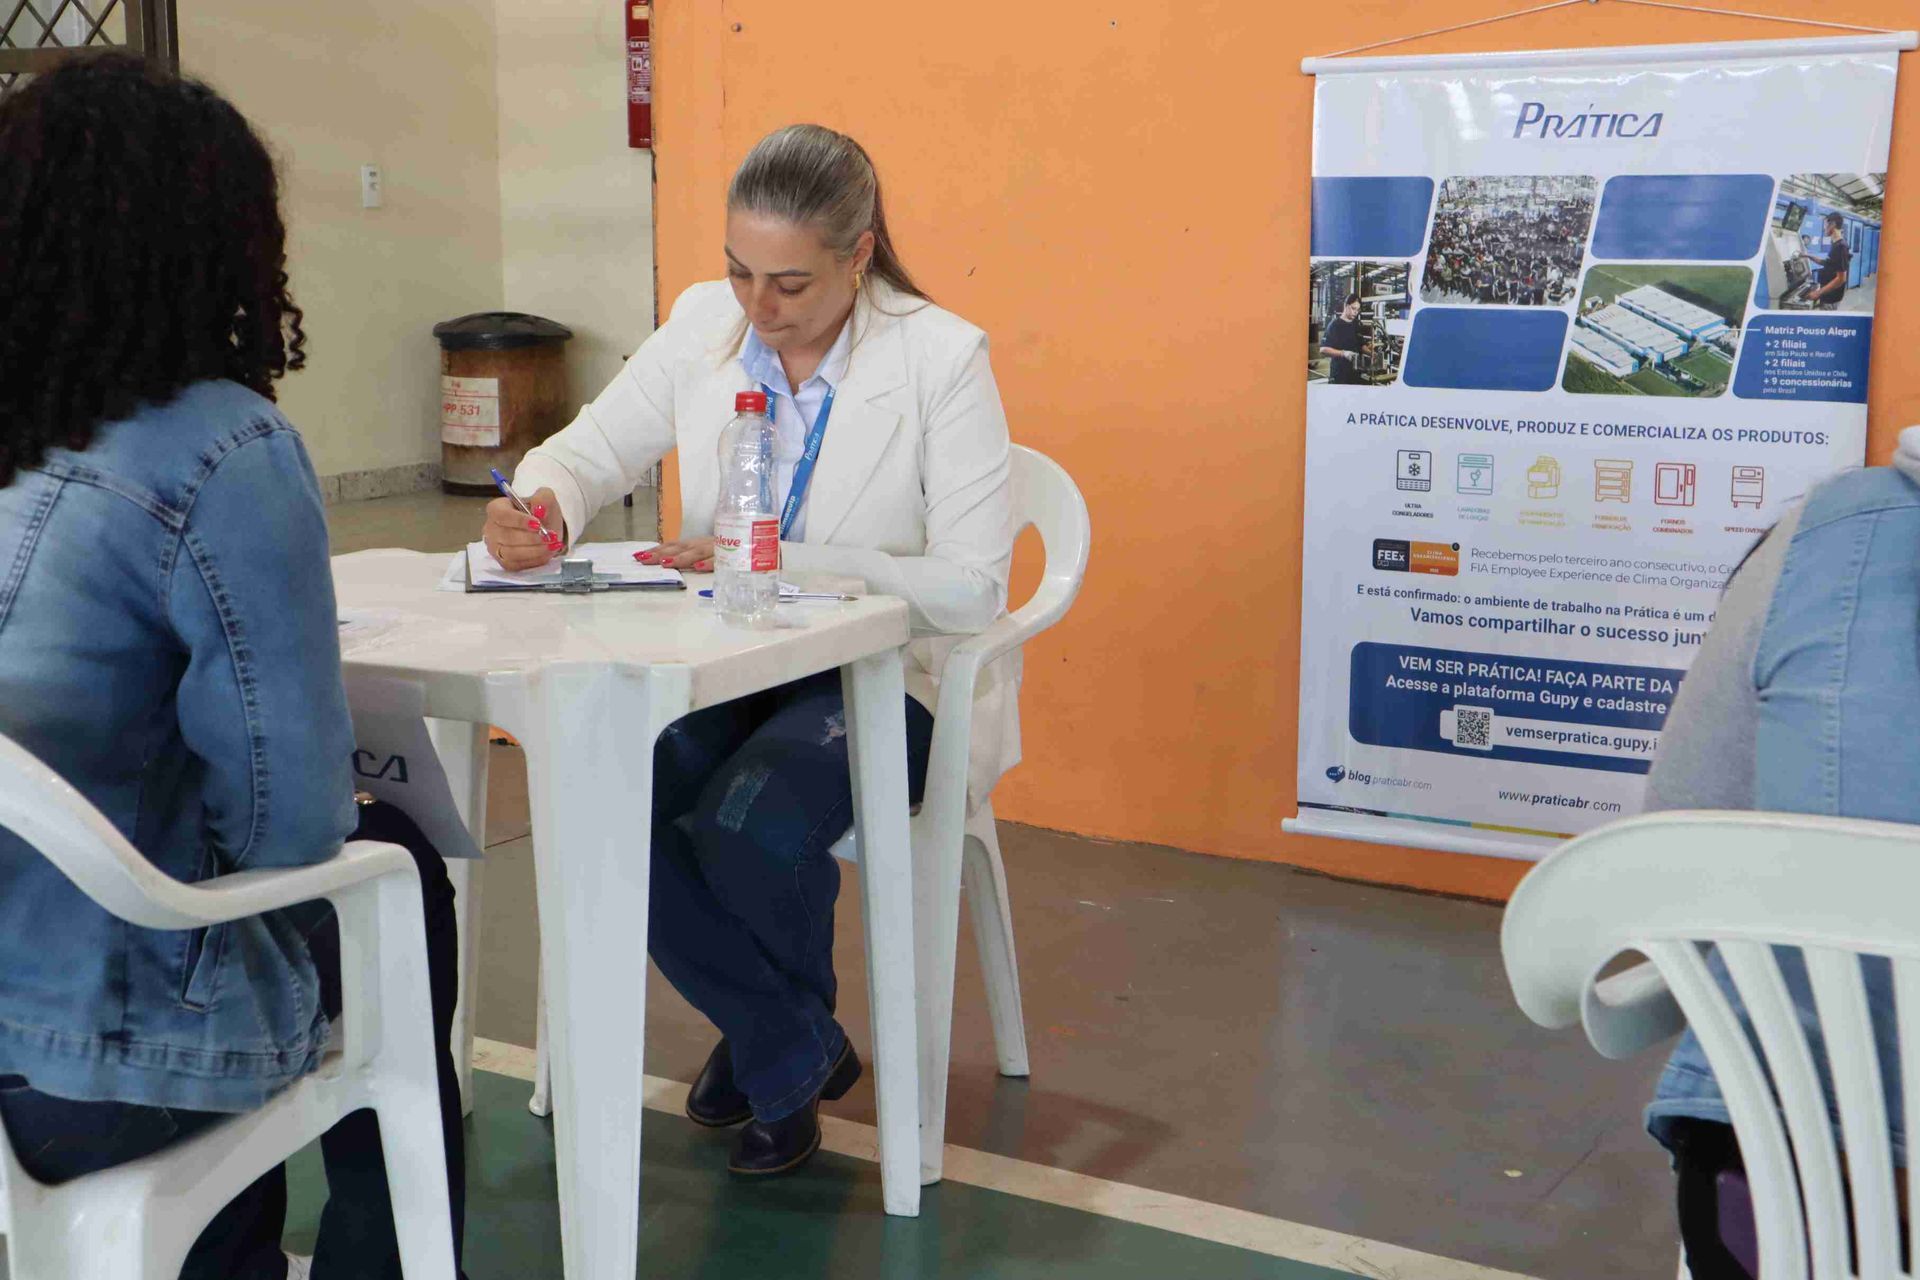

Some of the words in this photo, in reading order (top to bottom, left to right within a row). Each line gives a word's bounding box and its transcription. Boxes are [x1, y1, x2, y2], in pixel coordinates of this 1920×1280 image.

[1765, 326, 1795, 335] Matriz
[1797, 326, 1826, 335] Pouso
[1828, 327, 1857, 337] Alegre
[1774, 340, 1779, 348] 2
[1782, 340, 1807, 349] filiais
[1772, 359, 1778, 367] 2
[1781, 359, 1806, 368] filiais
[1771, 377, 1778, 385] 9
[1779, 378, 1852, 388] concessionárias
[460, 404, 480, 416] 531
[1346, 412, 1356, 425] A
[1360, 411, 1417, 428] PRÁTICA
[1421, 416, 1513, 434] DESENVOLVE,
[1517, 420, 1577, 436] PRODUZ
[1580, 423, 1589, 436] E
[1592, 423, 1708, 441] COMERCIALIZA
[1712, 428, 1733, 441] OS
[1738, 429, 1829, 446] PRODUTOS:
[1377, 549, 1405, 562] FEEx
[1471, 547, 1537, 562] Recebemos
[1539, 553, 1563, 564] pelo
[1565, 555, 1608, 567] terceiro
[1609, 559, 1632, 569] ano
[1633, 560, 1707, 574] consecutivo,
[1708, 565, 1716, 573] o
[1470, 562, 1489, 574] FIA
[1491, 564, 1547, 578] Employee
[1550, 568, 1613, 583] Experience
[1615, 573, 1631, 583] de
[1632, 573, 1667, 586] Clima
[1357, 584, 1364, 595] E
[1367, 586, 1391, 597] está
[1394, 588, 1461, 604] confirmado:
[1464, 596, 1471, 604] o
[1474, 595, 1530, 610] ambiente
[1533, 599, 1548, 611] de
[1551, 600, 1602, 615] trabalho
[1605, 605, 1621, 616] na
[1624, 605, 1669, 620] Prática
[1673, 609, 1680, 620] é
[1684, 612, 1704, 622] um
[1410, 606, 1464, 626] Vamos
[1468, 615, 1575, 636] compartilhar
[1580, 625, 1591, 637] o
[1596, 626, 1669, 643] sucesso
[1399, 655, 1432, 672] VEM
[1435, 659, 1464, 676] SER
[1468, 661, 1542, 683] PRÁTICA!
[1545, 670, 1588, 689] FAÇA
[1592, 673, 1646, 692] PARTE
[1650, 678, 1674, 694] DA
[1385, 674, 1439, 692] Acesse
[1441, 683, 1450, 694] a
[1453, 682, 1535, 703] plataforma
[1539, 690, 1579, 710] Gupy
[1583, 697, 1593, 708] e
[1596, 697, 1667, 714] cadastre
[1498, 790, 1622, 814] www.praticabr.com
